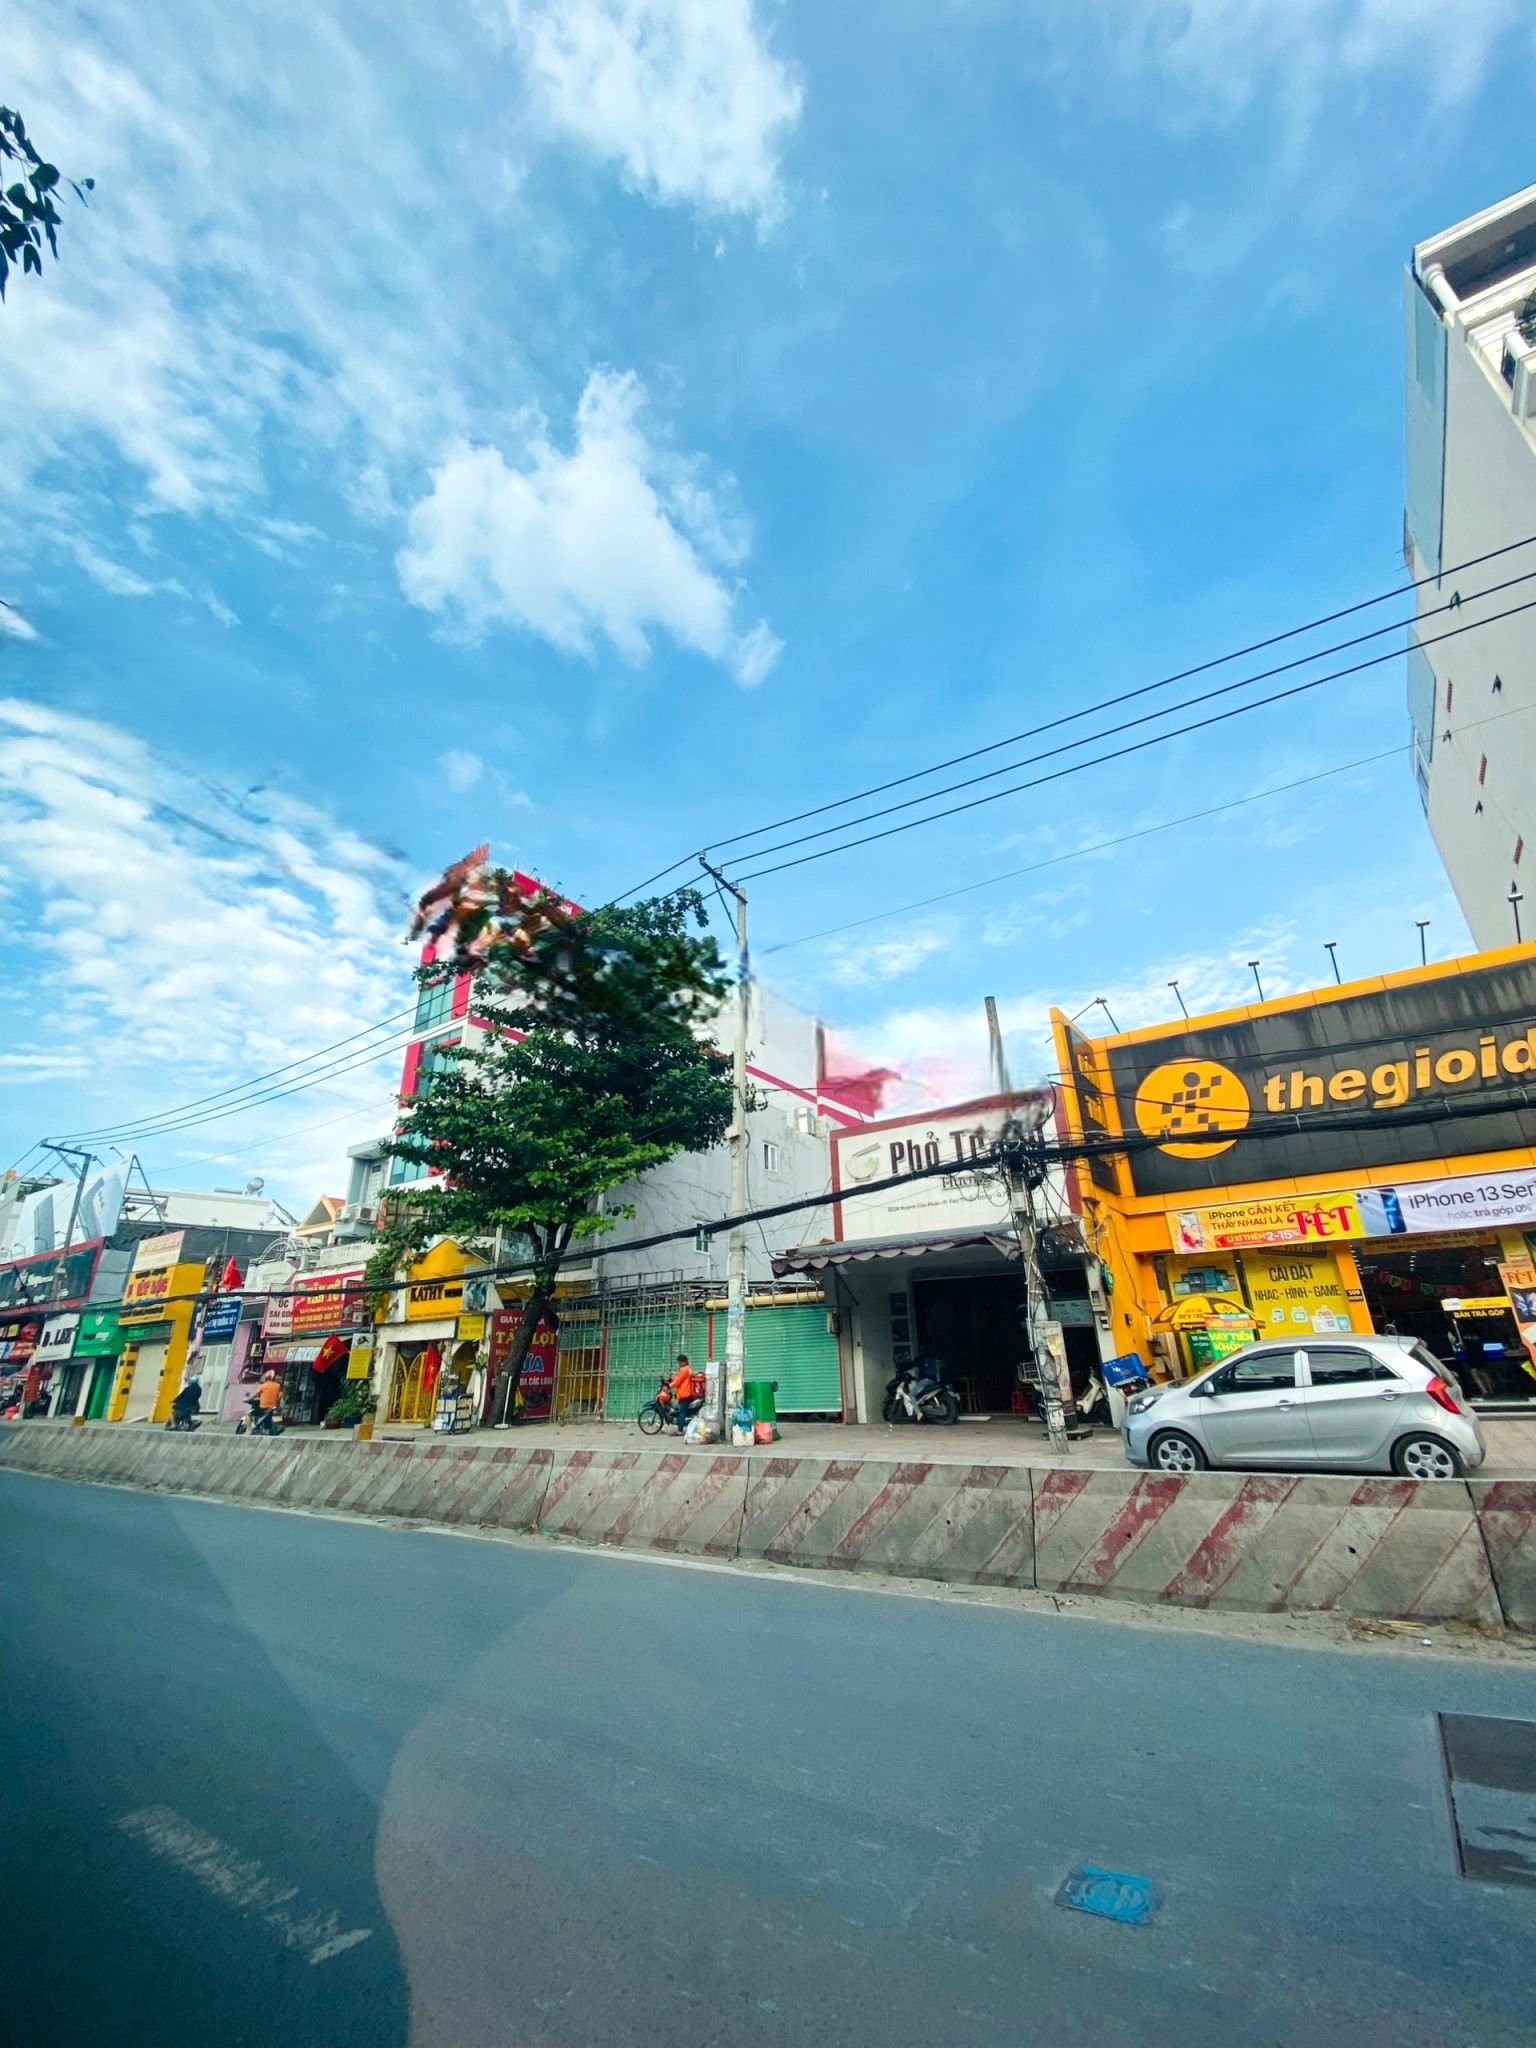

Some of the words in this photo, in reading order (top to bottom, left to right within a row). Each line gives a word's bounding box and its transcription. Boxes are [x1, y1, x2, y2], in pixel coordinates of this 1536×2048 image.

[889, 1130, 940, 1174] Phở
[1408, 1190, 1475, 1209] iPhone
[1476, 1186, 1499, 1201] 13
[1208, 1210, 1245, 1220] iPhone
[1238, 1217, 1267, 1227] NHAU
[1270, 1214, 1283, 1224] LÀ
[1287, 1203, 1352, 1236] TẾT
[1492, 1206, 1513, 1217] góp
[1268, 1264, 1289, 1282] CÀI
[1290, 1262, 1314, 1283] ĐẶT
[410, 1285, 445, 1303] KATHY
[1254, 1289, 1279, 1303] NHẠC
[1285, 1285, 1308, 1299] HÌNH
[1313, 1284, 1341, 1297] GAME
[1210, 1331, 1226, 1342] VAY
